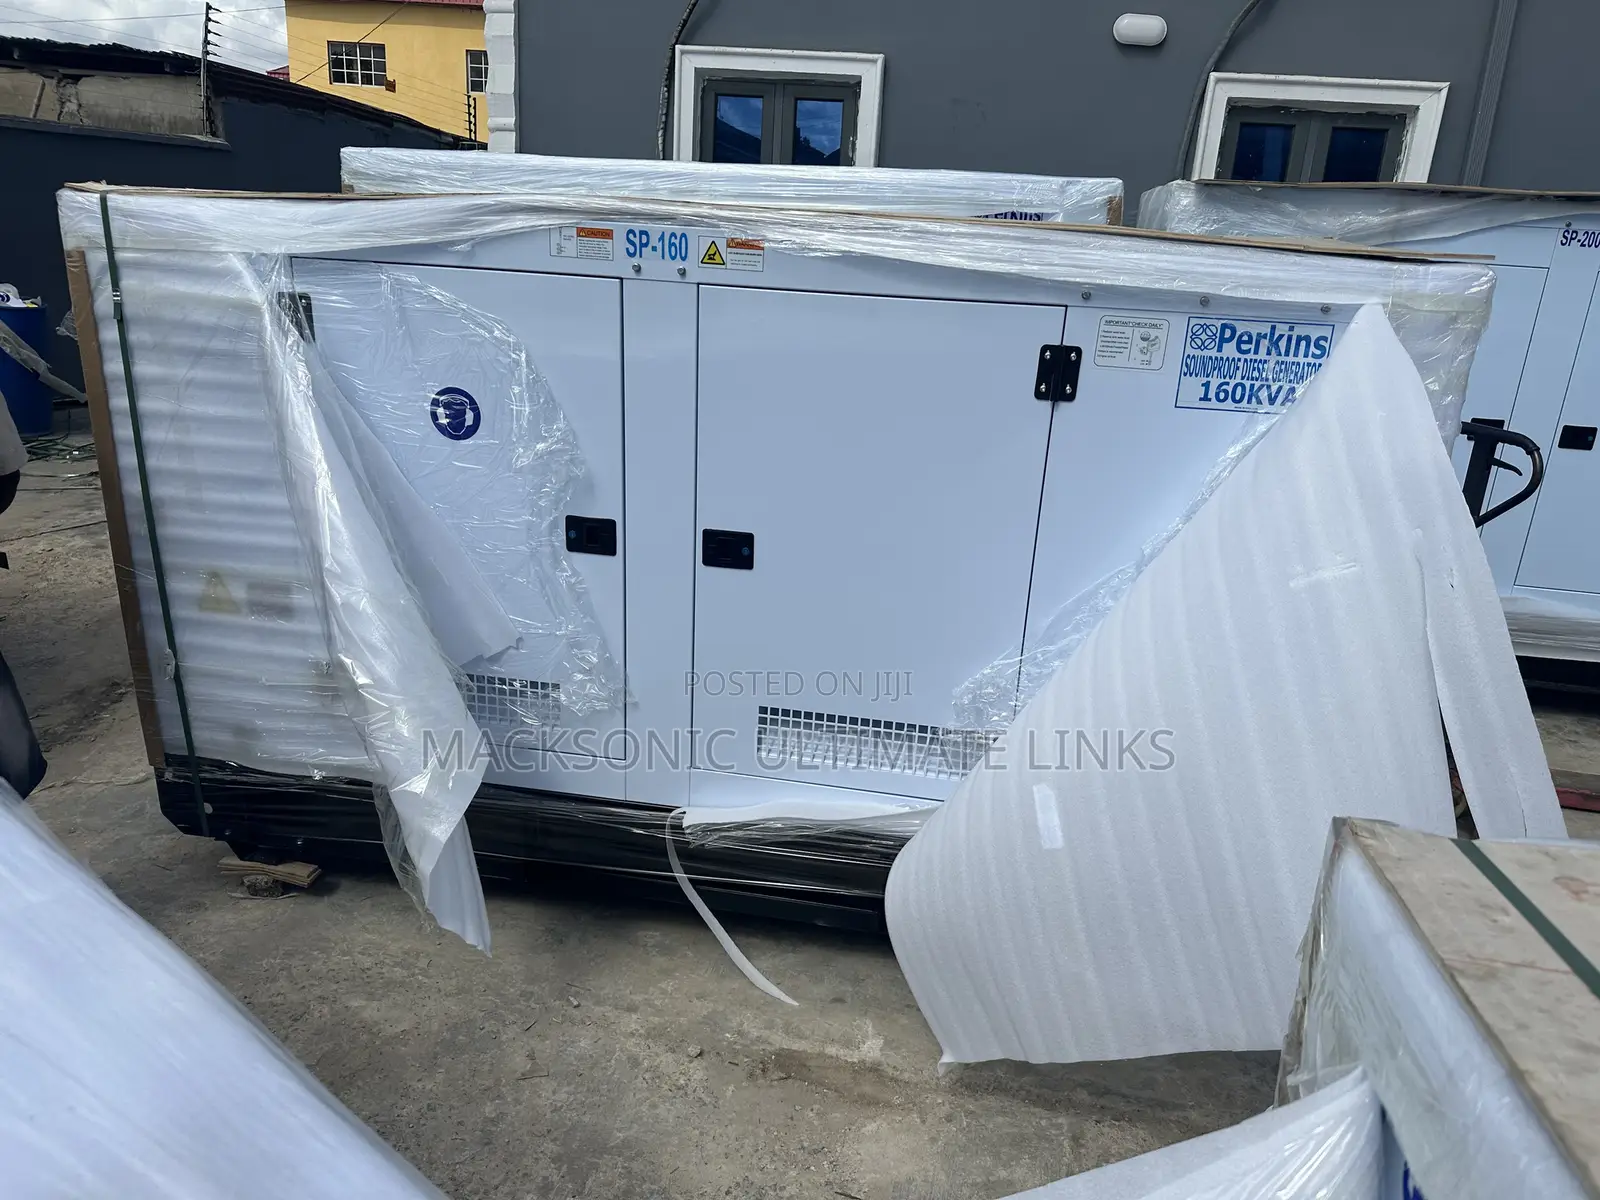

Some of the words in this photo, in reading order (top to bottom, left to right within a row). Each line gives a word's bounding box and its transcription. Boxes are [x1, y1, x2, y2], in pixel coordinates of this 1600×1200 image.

[625, 228, 689, 262] SP-160
[1216, 323, 1329, 359] Perkins
[1183, 354, 1241, 380] SOUNDPROOF
[1241, 358, 1271, 383] DIESEL
[1199, 381, 1297, 407] 160KVA
